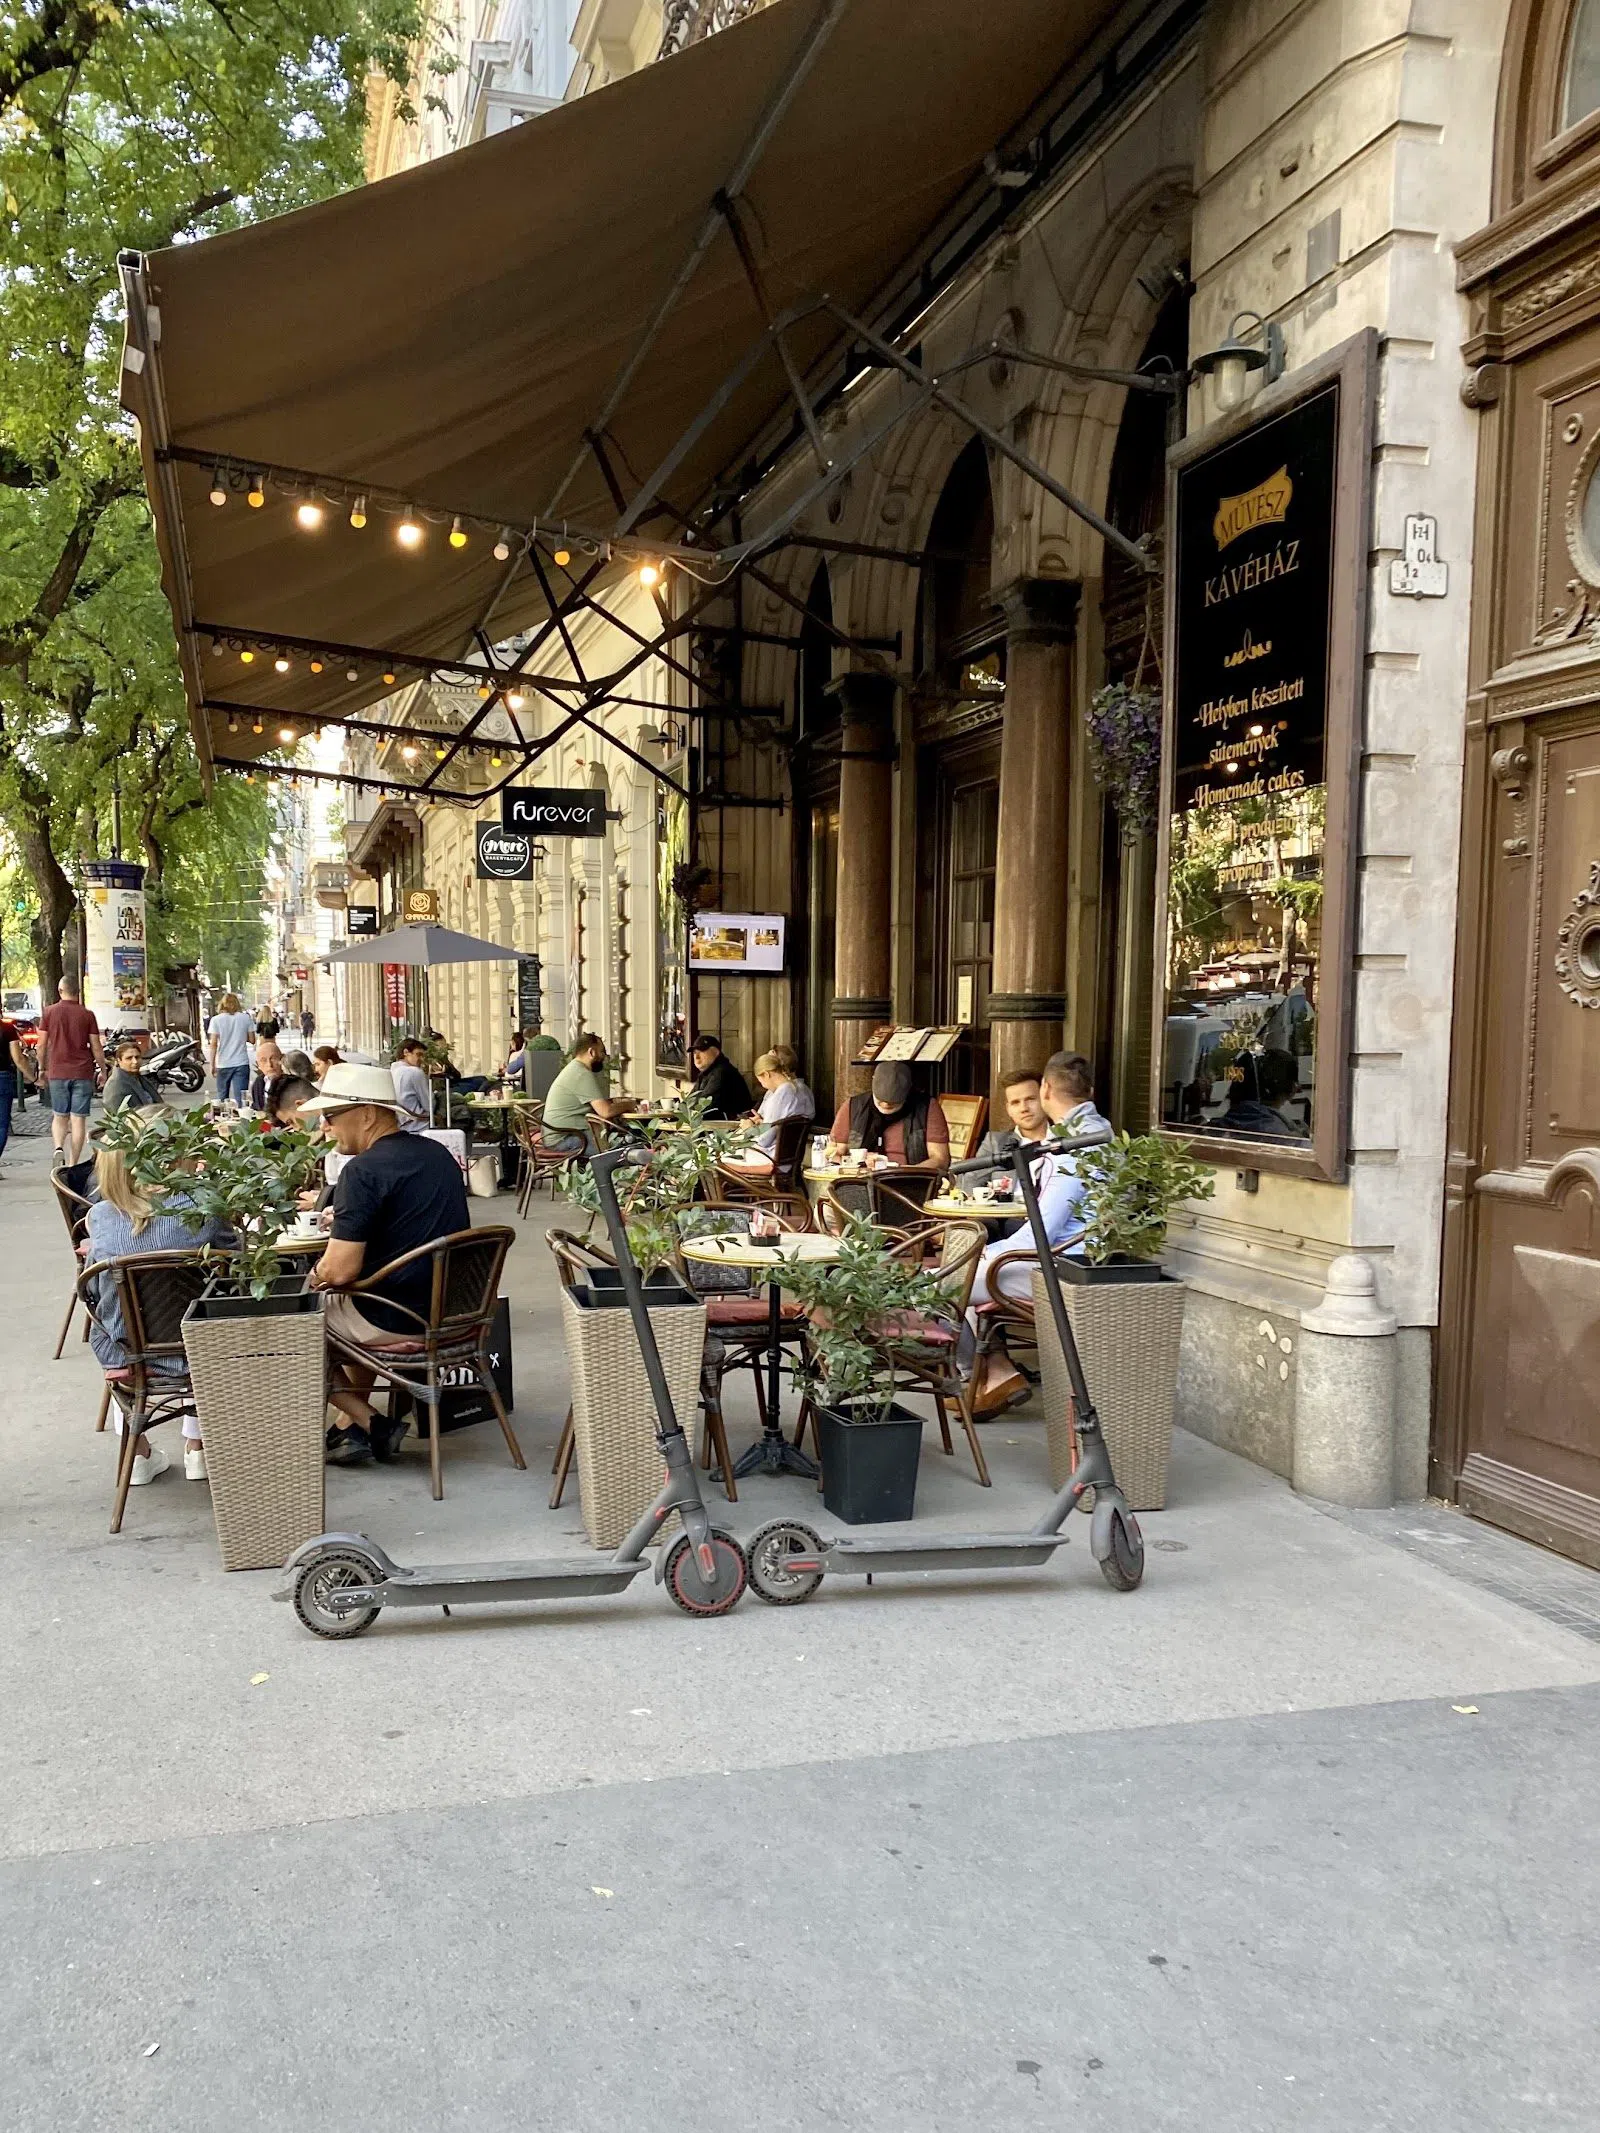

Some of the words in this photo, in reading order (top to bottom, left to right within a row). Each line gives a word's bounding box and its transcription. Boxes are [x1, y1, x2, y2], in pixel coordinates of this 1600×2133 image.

[1204, 540, 1300, 607] KÁVÉHÁZ
[1251, 676, 1305, 711] készített
[1268, 764, 1305, 793] cakes
[513, 801, 595, 823] furever
